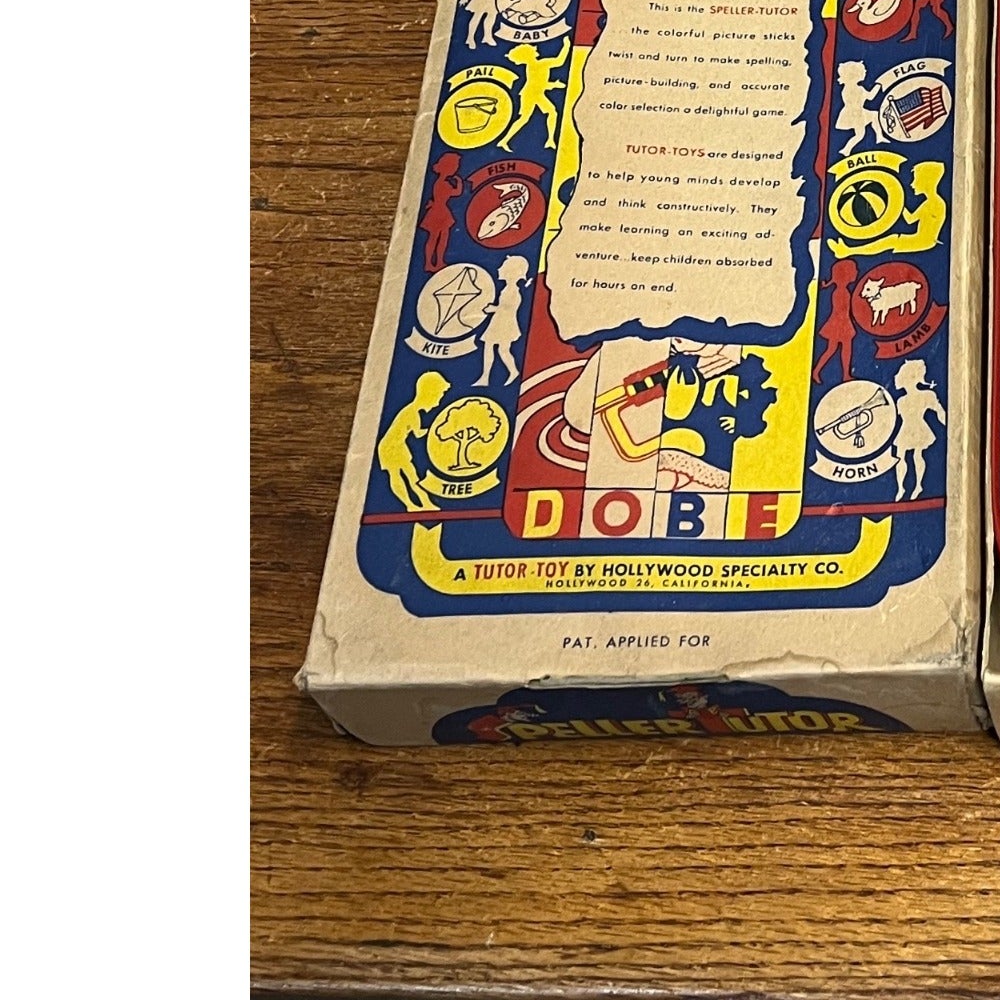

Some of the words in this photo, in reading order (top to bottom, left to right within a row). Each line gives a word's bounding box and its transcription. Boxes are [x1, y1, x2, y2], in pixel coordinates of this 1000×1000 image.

[649, 2, 669, 12] This
[674, 3, 682, 12] is
[687, 4, 704, 14] the
[709, 5, 799, 16] SPELLER-TUTOR
[513, 29, 551, 41] BABY
[657, 28, 705, 38] colorful
[713, 31, 756, 41] picture
[763, 32, 796, 41] sticks
[608, 51, 634, 60] twist
[638, 52, 660, 61] and
[665, 54, 688, 63] turn
[693, 55, 705, 63] to
[710, 56, 740, 65] make
[746, 57, 792, 68] spelling,
[465, 67, 495, 79] PAIL
[893, 62, 927, 78] FLAG
[708, 81, 731, 90] and
[741, 83, 790, 92] accurate
[599, 101, 628, 110] color
[631, 103, 680, 113] selection
[694, 106, 749, 118] delightful
[752, 109, 788, 119] game.
[626, 144, 705, 158] TUTOR-TOYS
[707, 151, 728, 159] are
[731, 150, 784, 161] designed
[487, 162, 516, 176] FISH
[846, 154, 878, 169] BALL
[588, 171, 600, 179] to
[606, 171, 635, 182] help
[640, 175, 680, 185] young
[687, 176, 724, 186] minds
[729, 177, 781, 188] develop
[583, 198, 607, 207] and
[618, 200, 646, 209] think
[656, 201, 740, 215] constructively.
[751, 205, 778, 216] They
[579, 223, 612, 232] make
[620, 224, 669, 238] learning
[678, 229, 693, 237] an
[701, 229, 748, 240] exciting
[755, 230, 776, 239] ad-
[663, 255, 712, 266] children
[716, 257, 773, 267] absorbed
[570, 278, 588, 288] for
[592, 280, 626, 290] hours
[630, 283, 645, 291] on
[650, 283, 677, 293] end.
[895, 323, 931, 353] LAMB
[421, 341, 450, 356] KITE
[832, 463, 879, 479] HORN
[441, 483, 473, 495] TREE
[522, 489, 779, 540] DOBE
[453, 568, 467, 582] A
[474, 562, 569, 579] TUTOR-TOY
[575, 564, 595, 577] BY
[602, 563, 714, 577] HOLLYWOOD
[721, 563, 808, 578] SPECIALTY
[814, 561, 844, 576] CO.
[545, 579, 628, 588] HOLLYWOOD
[636, 578, 654, 588] 26,
[606, 635, 670, 648] APPLIED
[679, 635, 711, 648] FOR
